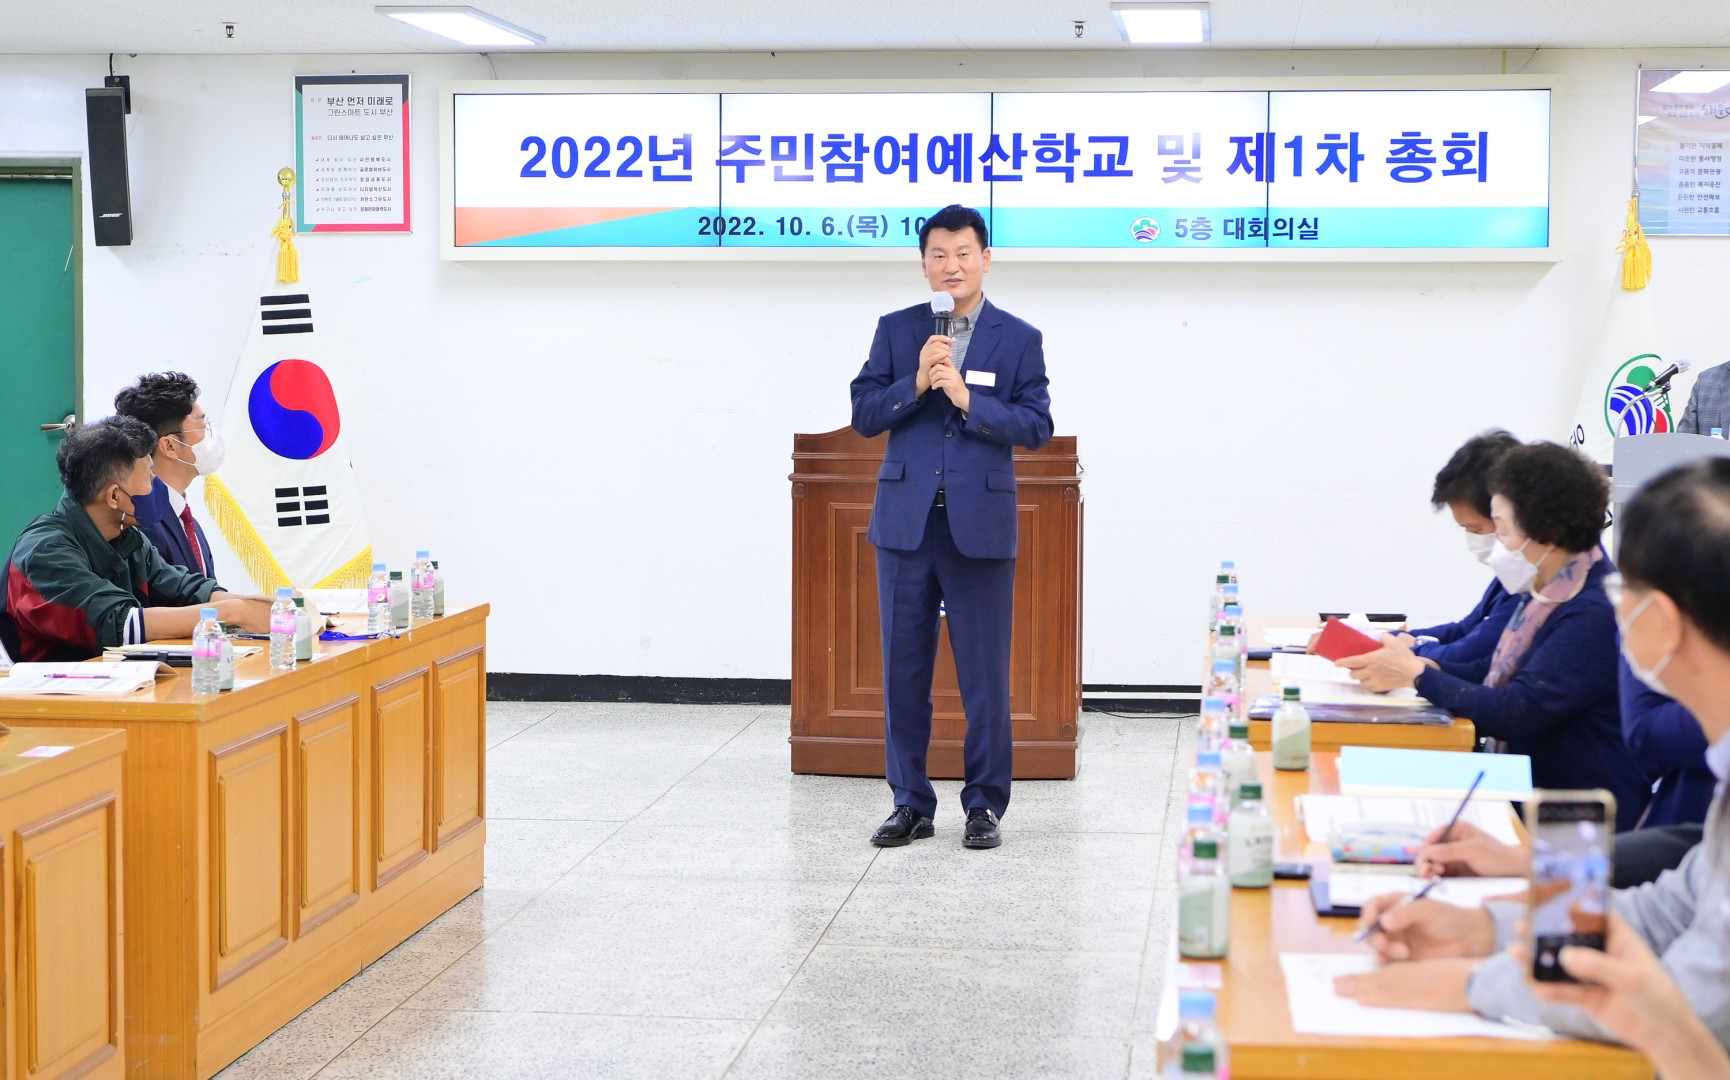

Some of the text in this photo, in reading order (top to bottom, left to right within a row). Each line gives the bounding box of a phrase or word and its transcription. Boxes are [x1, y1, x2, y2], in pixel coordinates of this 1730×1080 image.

[327, 97, 393, 106] 부산 먼저 미래로
[520, 131, 1489, 184] 2022년 주민참여예산학교 및 제1차 총회
[698, 216, 764, 236] 2022.
[776, 216, 811, 236] 10.
[821, 214, 889, 239] 6.(목)
[1174, 217, 1319, 241] 5층 대회의실
